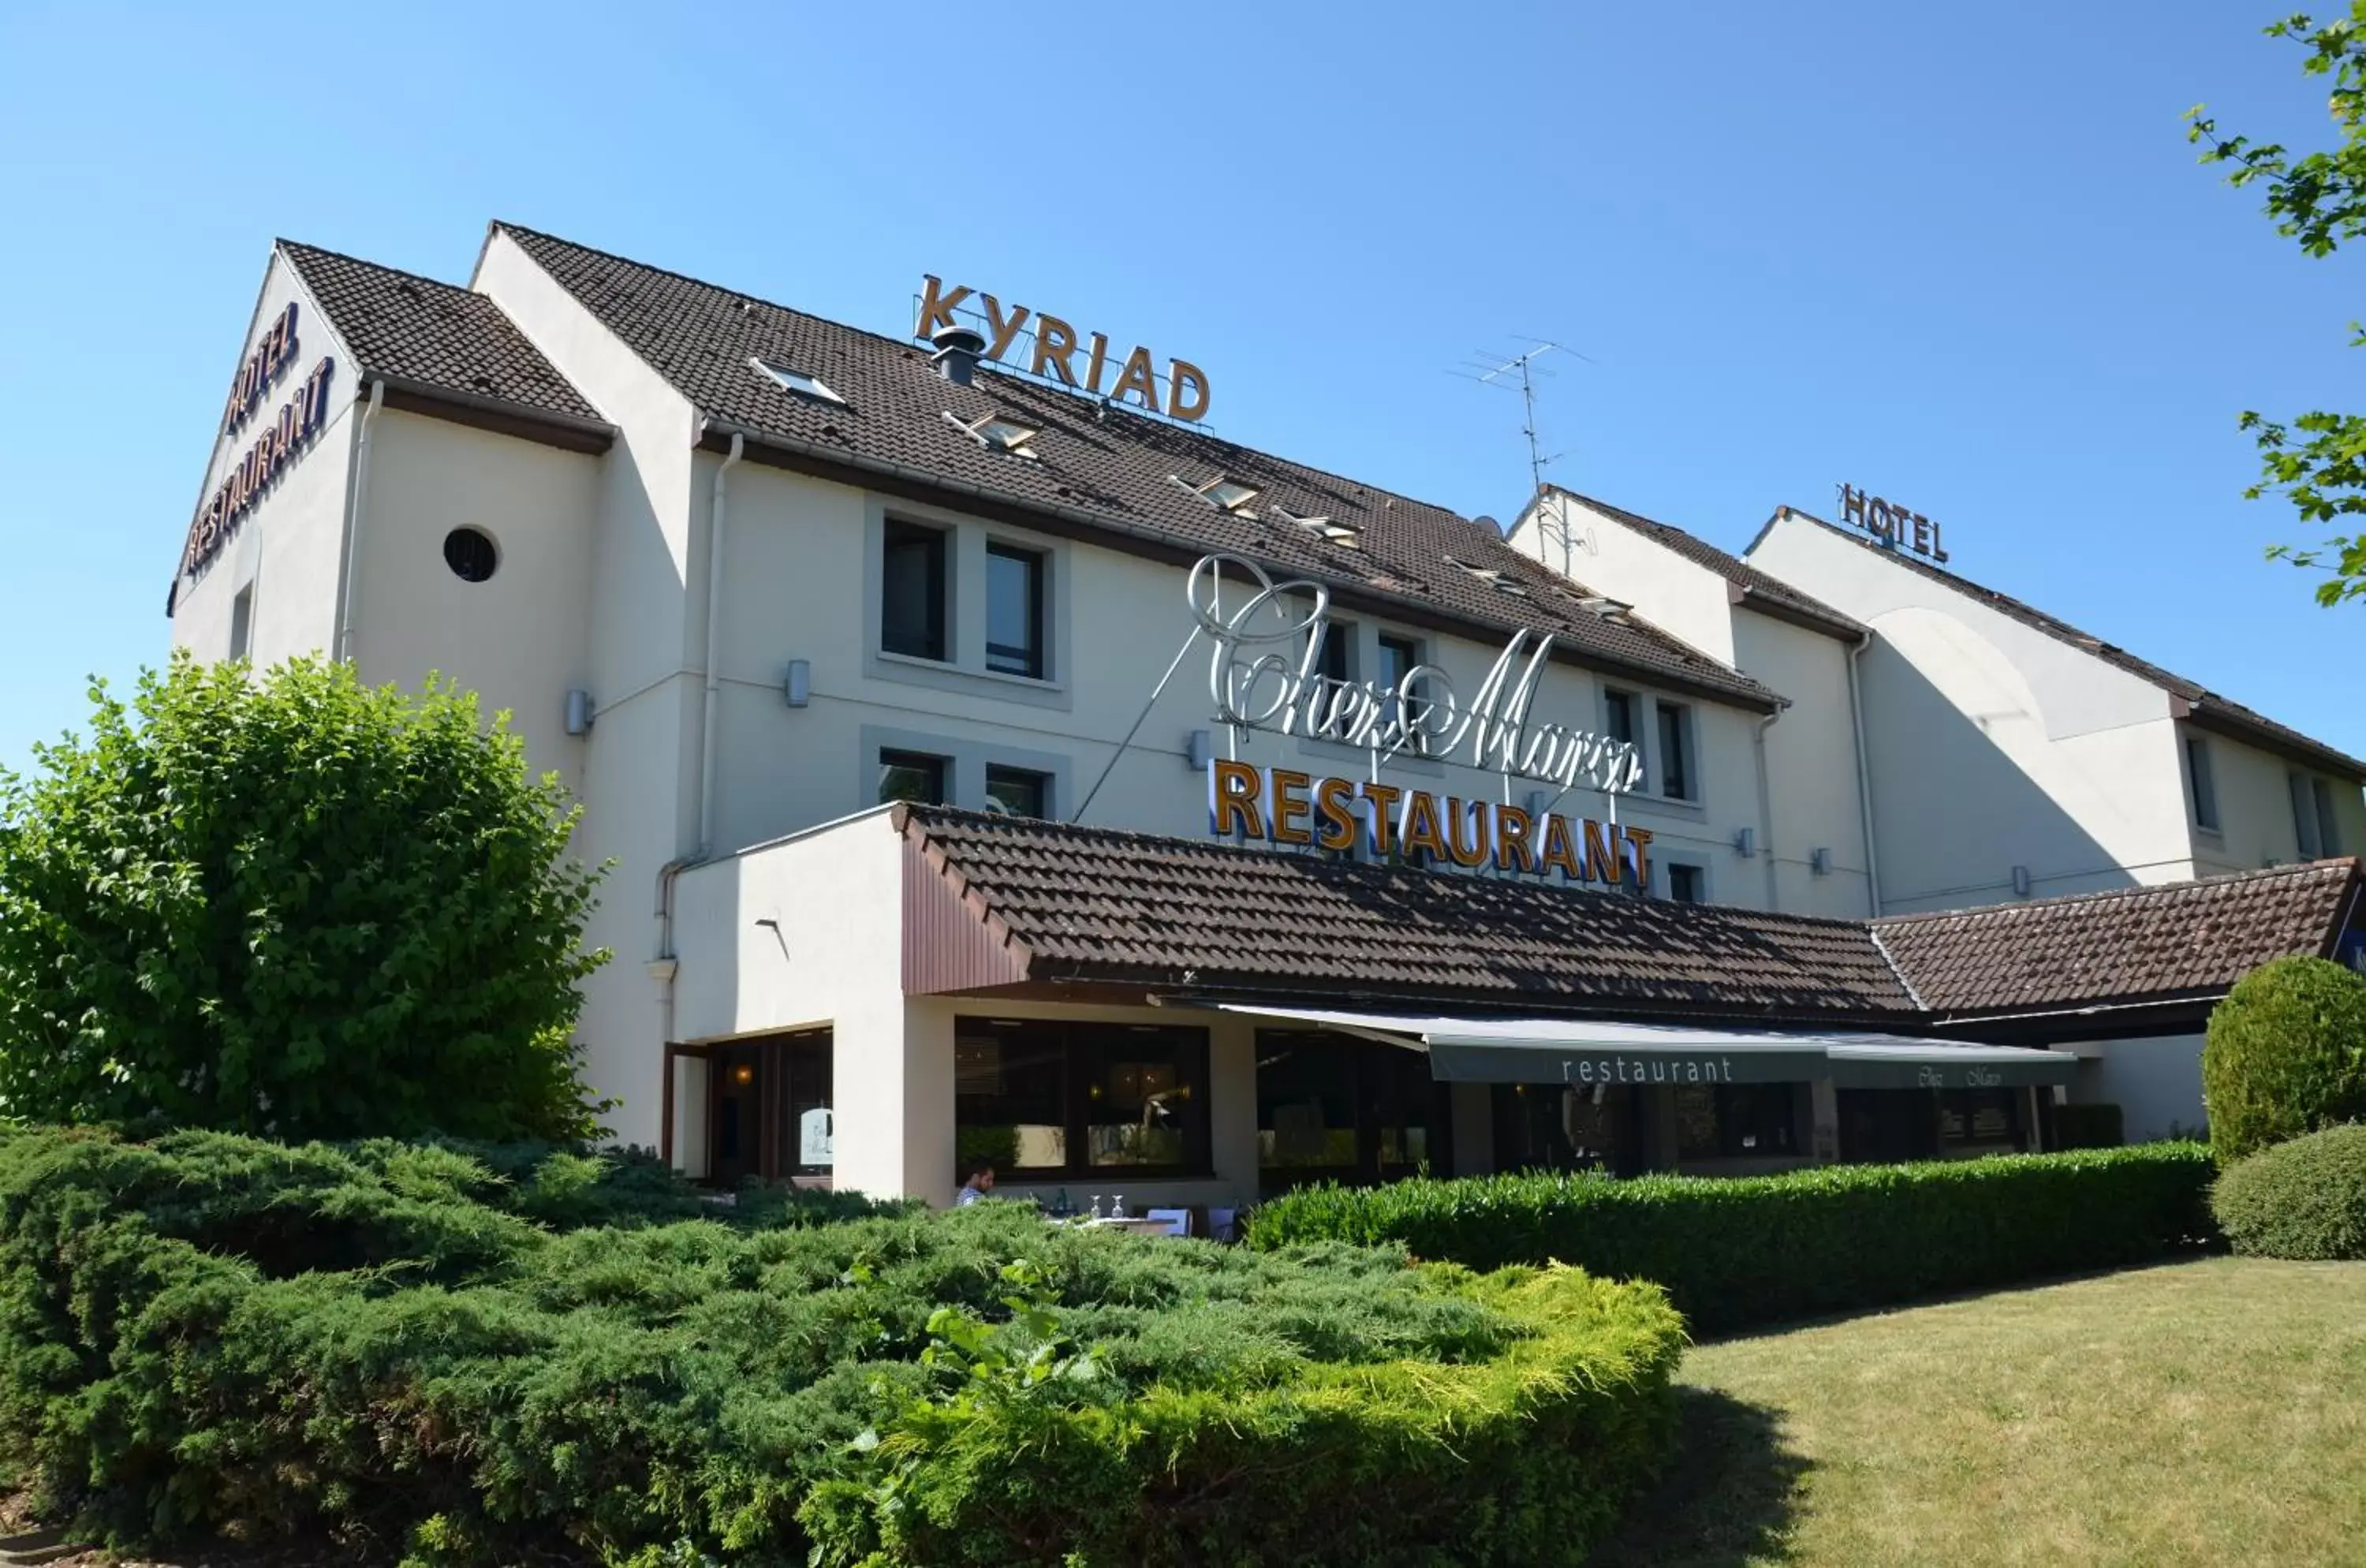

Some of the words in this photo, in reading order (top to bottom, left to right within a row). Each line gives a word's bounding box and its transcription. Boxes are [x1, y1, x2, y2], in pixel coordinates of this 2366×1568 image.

[226, 301, 300, 435] HOTEL
[915, 274, 1210, 420] KYRIAD
[186, 356, 334, 577] RESTAURANT
[1844, 483, 1948, 562] HOTEL
[1208, 758, 1654, 887] RESTAURANT
[1562, 1056, 1732, 1082] restaurant
